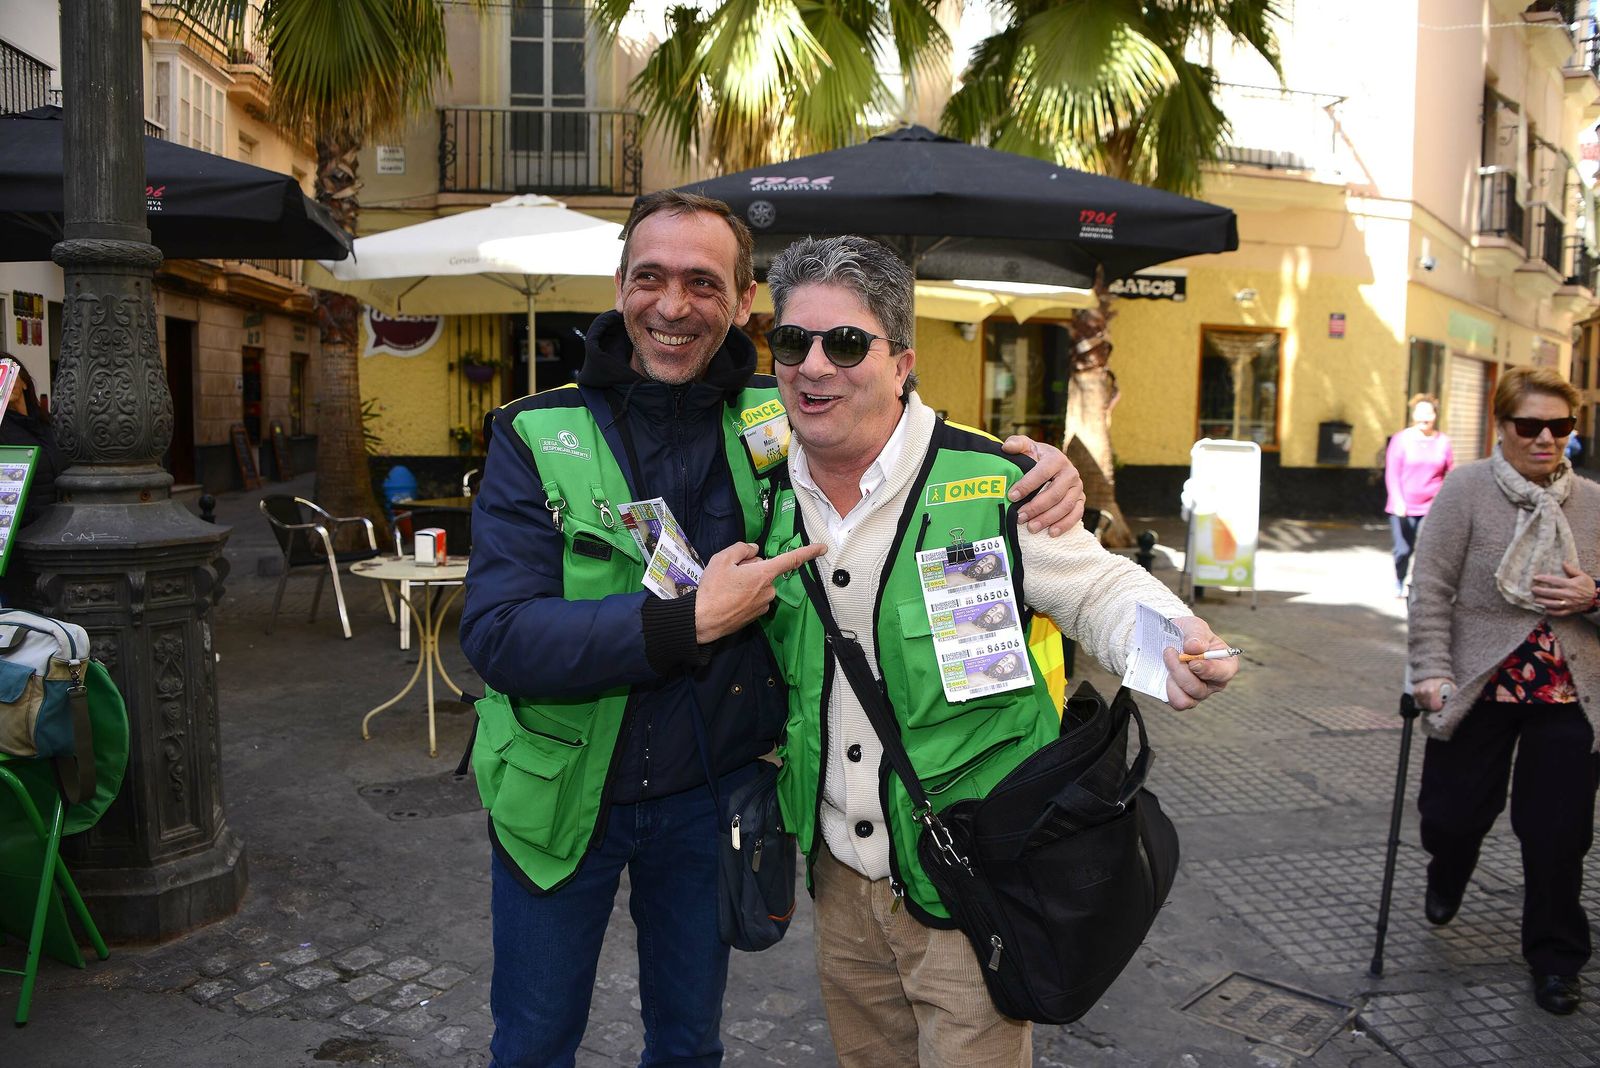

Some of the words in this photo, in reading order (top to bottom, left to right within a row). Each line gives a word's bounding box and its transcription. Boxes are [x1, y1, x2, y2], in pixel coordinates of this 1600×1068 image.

[145, 186, 165, 197] 06
[1079, 210, 1118, 225] 1906
[745, 403, 780, 424] ONCE
[949, 479, 1002, 499] ONCE
[974, 540, 1000, 554] 6506
[686, 568, 701, 582] 604
[976, 589, 1009, 603] 86506
[987, 639, 1020, 654] 86506
